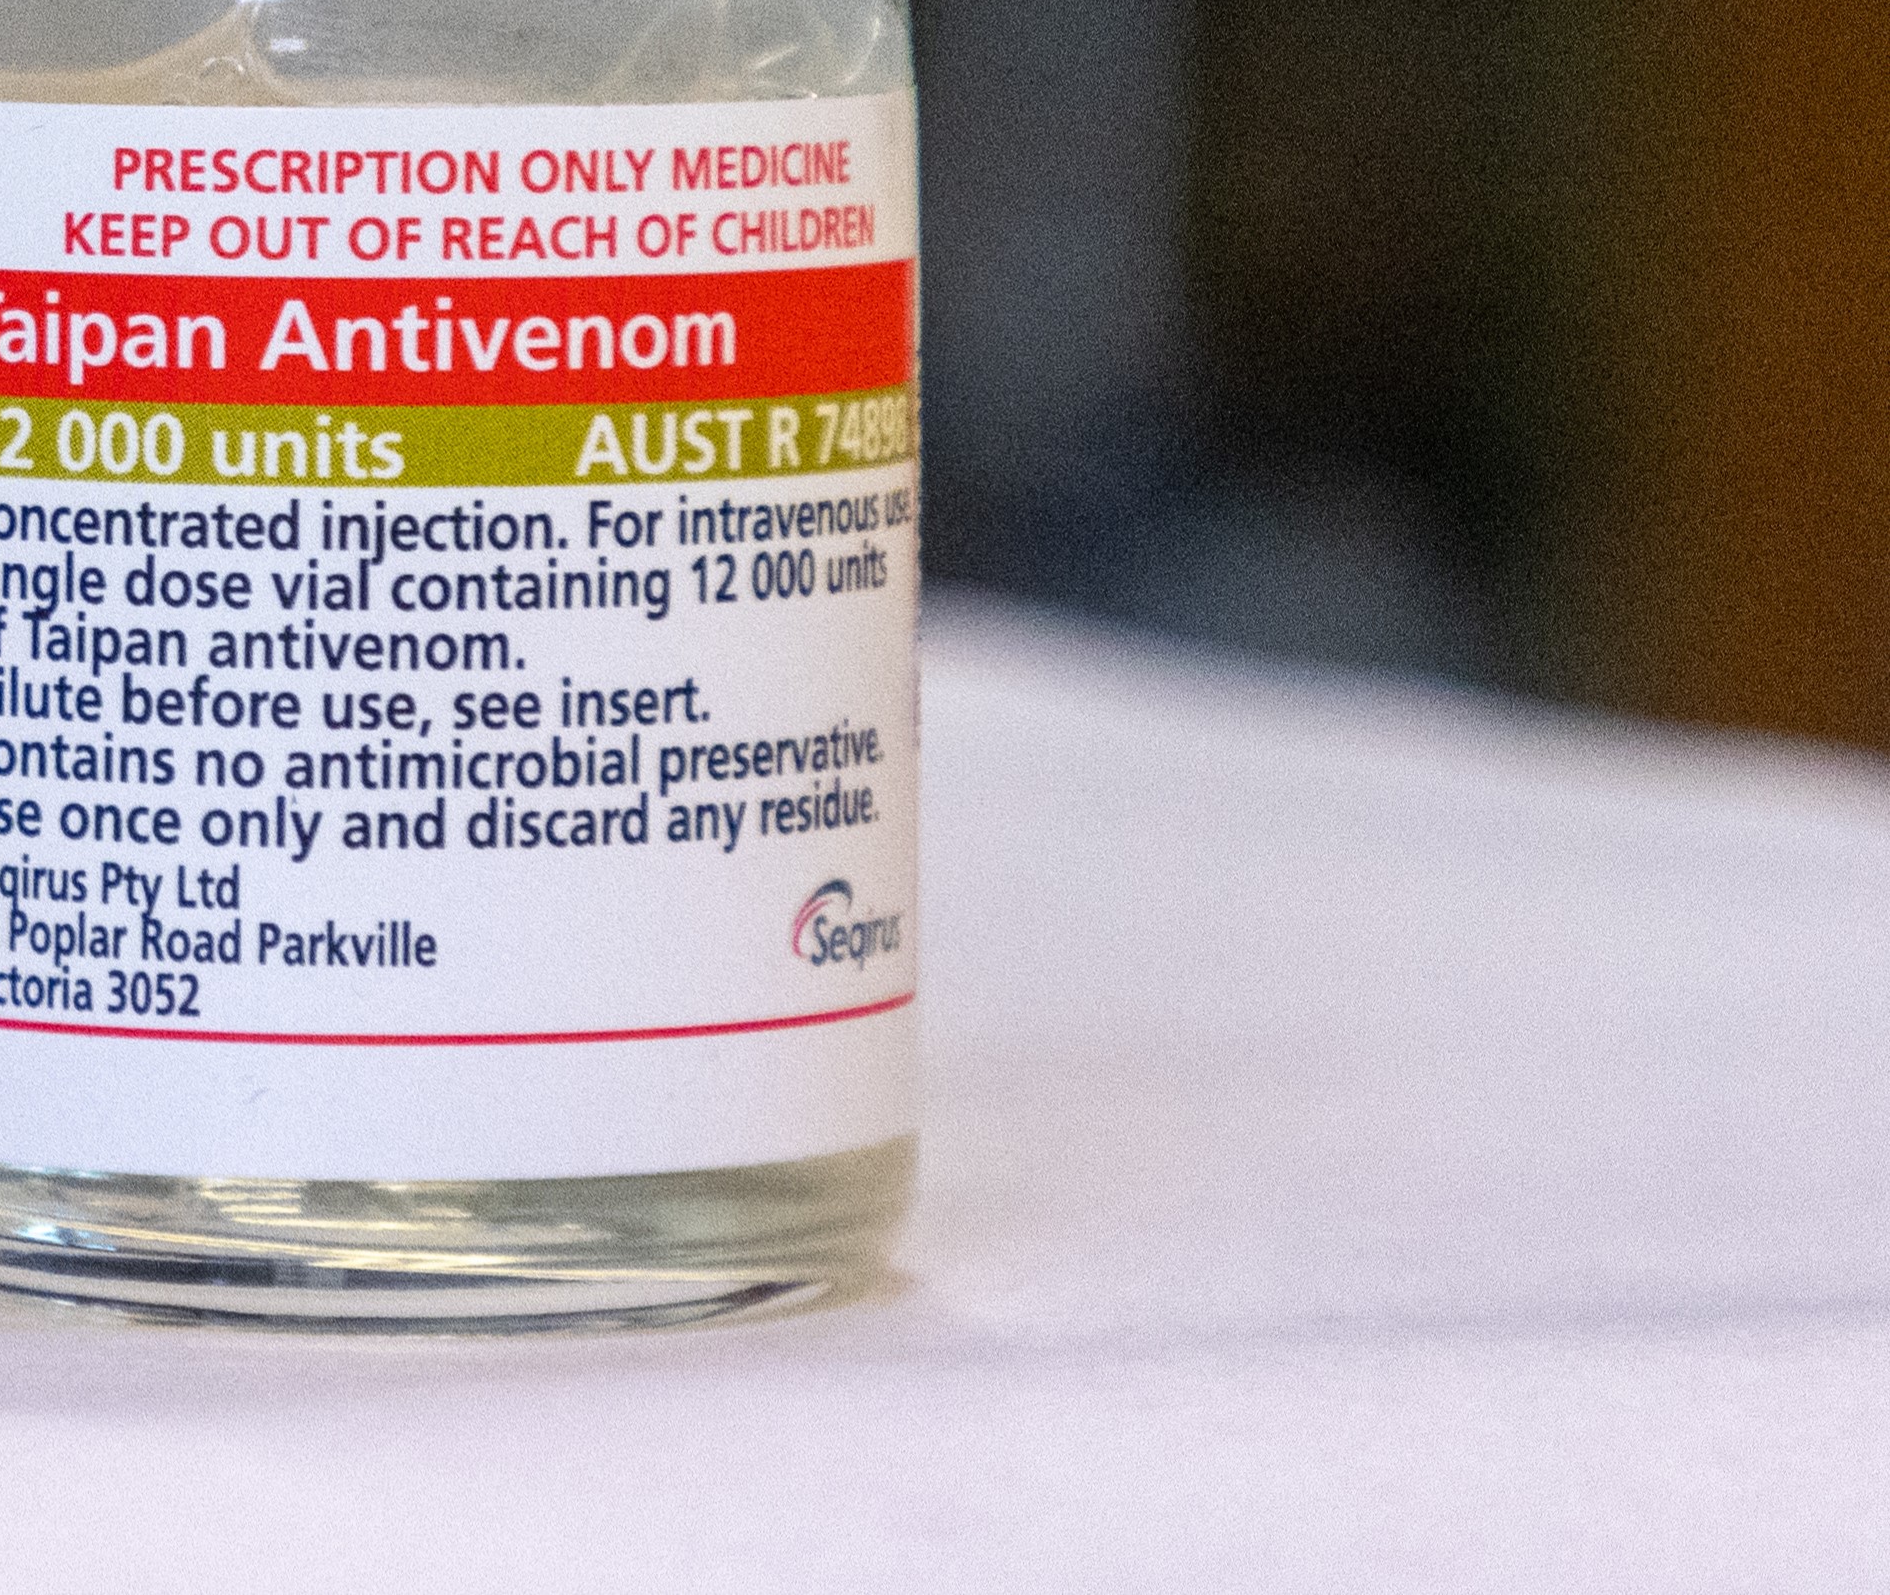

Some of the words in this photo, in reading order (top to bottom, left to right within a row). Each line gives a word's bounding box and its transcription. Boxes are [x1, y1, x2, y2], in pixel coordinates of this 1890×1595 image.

[113, 147, 500, 195] PRESCRIPTION
[519, 148, 655, 195] ONLY
[671, 140, 850, 191] MEDICINE
[63, 211, 191, 258] KEEP
[208, 214, 331, 261] OUT
[347, 216, 422, 262] OF
[441, 215, 618, 261] REACH
[636, 212, 697, 259] OF
[711, 205, 874, 257] CHILDREN
[260, 296, 735, 372] Antivenom
[57, 409, 185, 476] 000
[212, 414, 404, 479] units
[576, 409, 752, 476] AUST
[770, 407, 798, 467] R
[321, 499, 568, 567] injection.
[588, 499, 664, 549] For
[678, 494, 880, 545] intravenous
[123, 553, 253, 611] dose
[270, 550, 376, 612] vial
[390, 555, 671, 622] containing
[690, 552, 738, 604] 12
[751, 548, 816, 601] 000
[826, 541, 886, 595] units
[21, 606, 187, 678] Taipan
[207, 617, 526, 672] antivenom.
[121, 671, 302, 730] before
[322, 691, 432, 738] use,
[452, 691, 542, 731] see
[561, 676, 710, 728] insert.
[195, 748, 266, 789] no
[283, 732, 641, 791] antimicrobial
[659, 718, 882, 797] preservative.
[58, 802, 182, 846] once
[199, 794, 323, 864] only
[341, 796, 446, 851] and
[465, 791, 649, 850] discard
[666, 801, 747, 854] any
[759, 777, 878, 836] residue.
[100, 860, 164, 917] Pty
[176, 863, 241, 910] Ltd
[7, 913, 126, 964] Poplar
[140, 913, 242, 965] Road
[257, 920, 437, 968] Parkville
[106, 968, 201, 1018] 3052
